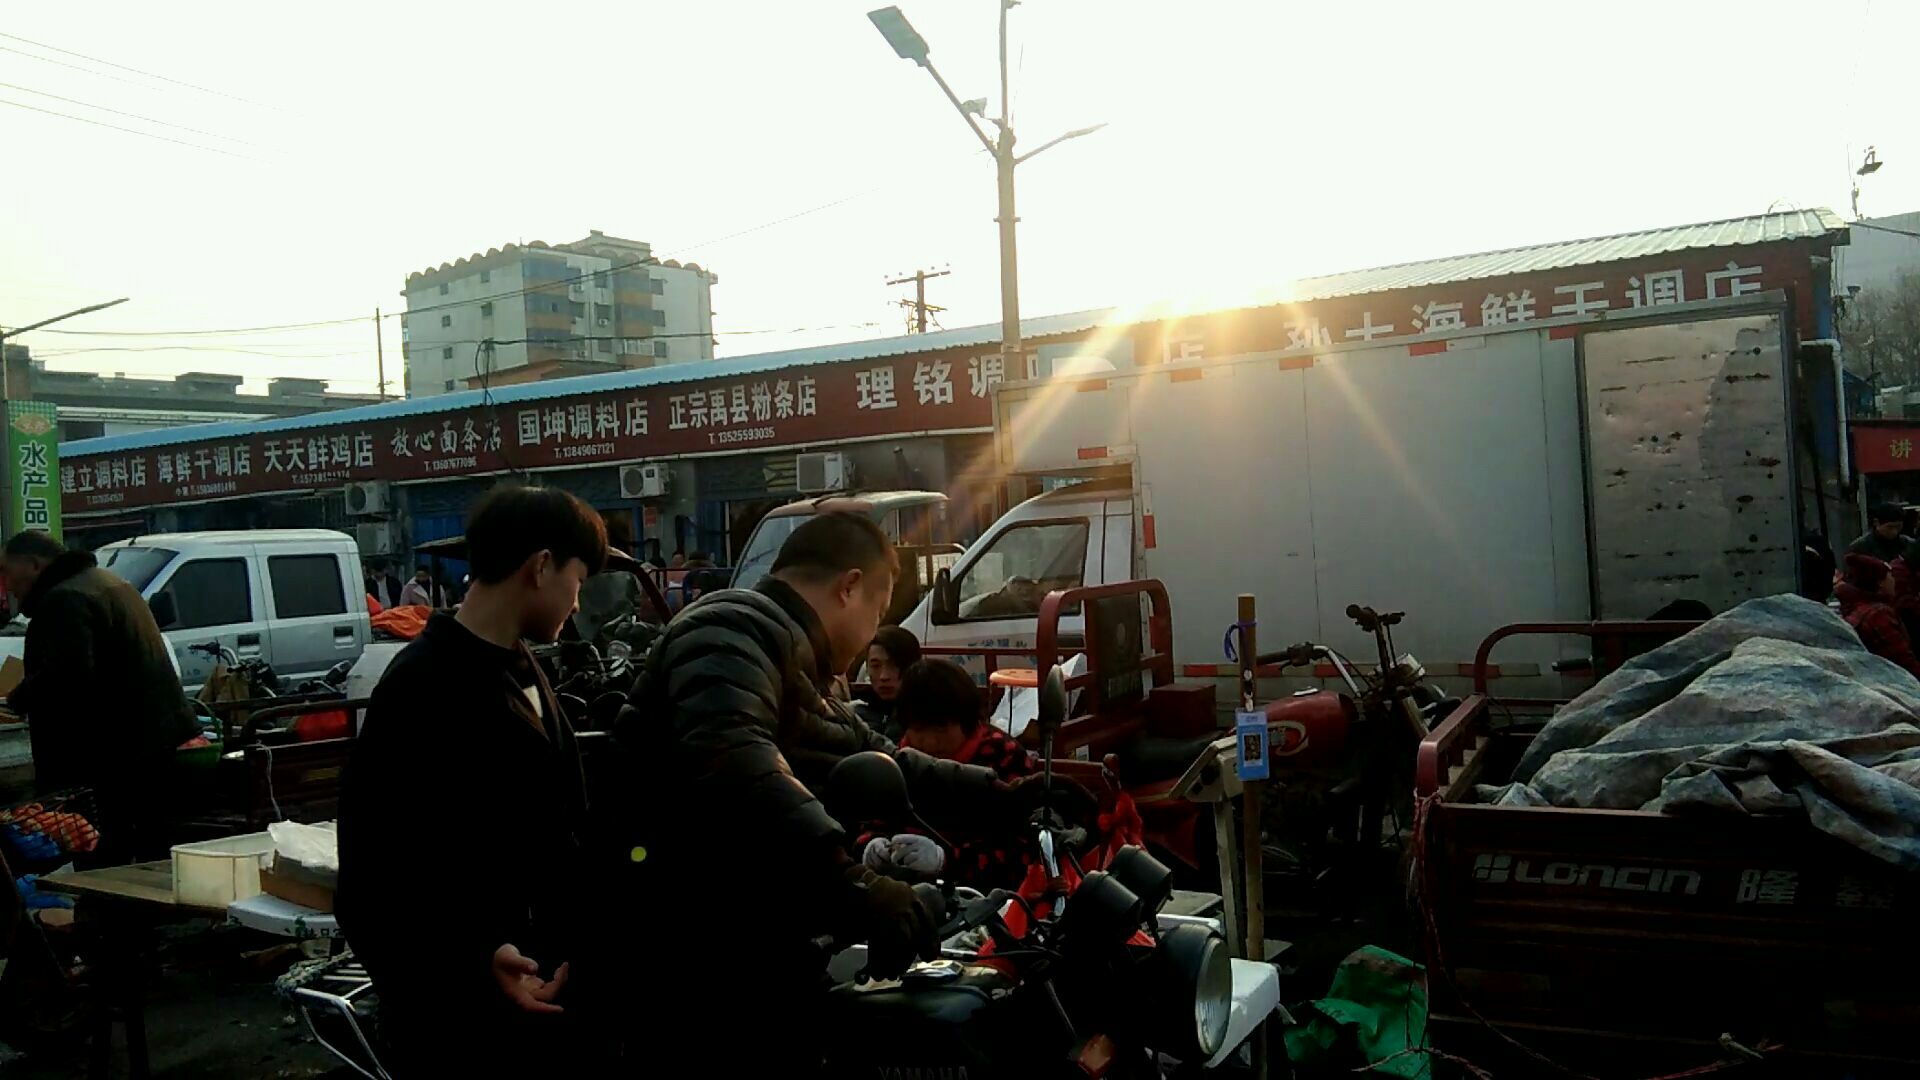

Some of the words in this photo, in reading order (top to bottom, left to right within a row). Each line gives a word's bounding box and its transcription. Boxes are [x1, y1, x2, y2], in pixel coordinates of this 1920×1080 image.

[668, 375, 817, 431] 正宗禹县粉条店
[855, 353, 1039, 410] 理铭调
[517, 399, 649, 447] 国坤调料店
[61, 454, 148, 494] 建立调料店
[157, 444, 251, 484] 海鲜干调店
[263, 431, 375, 474] 天天鲜鸡店
[19, 440, 50, 532] 水产品
